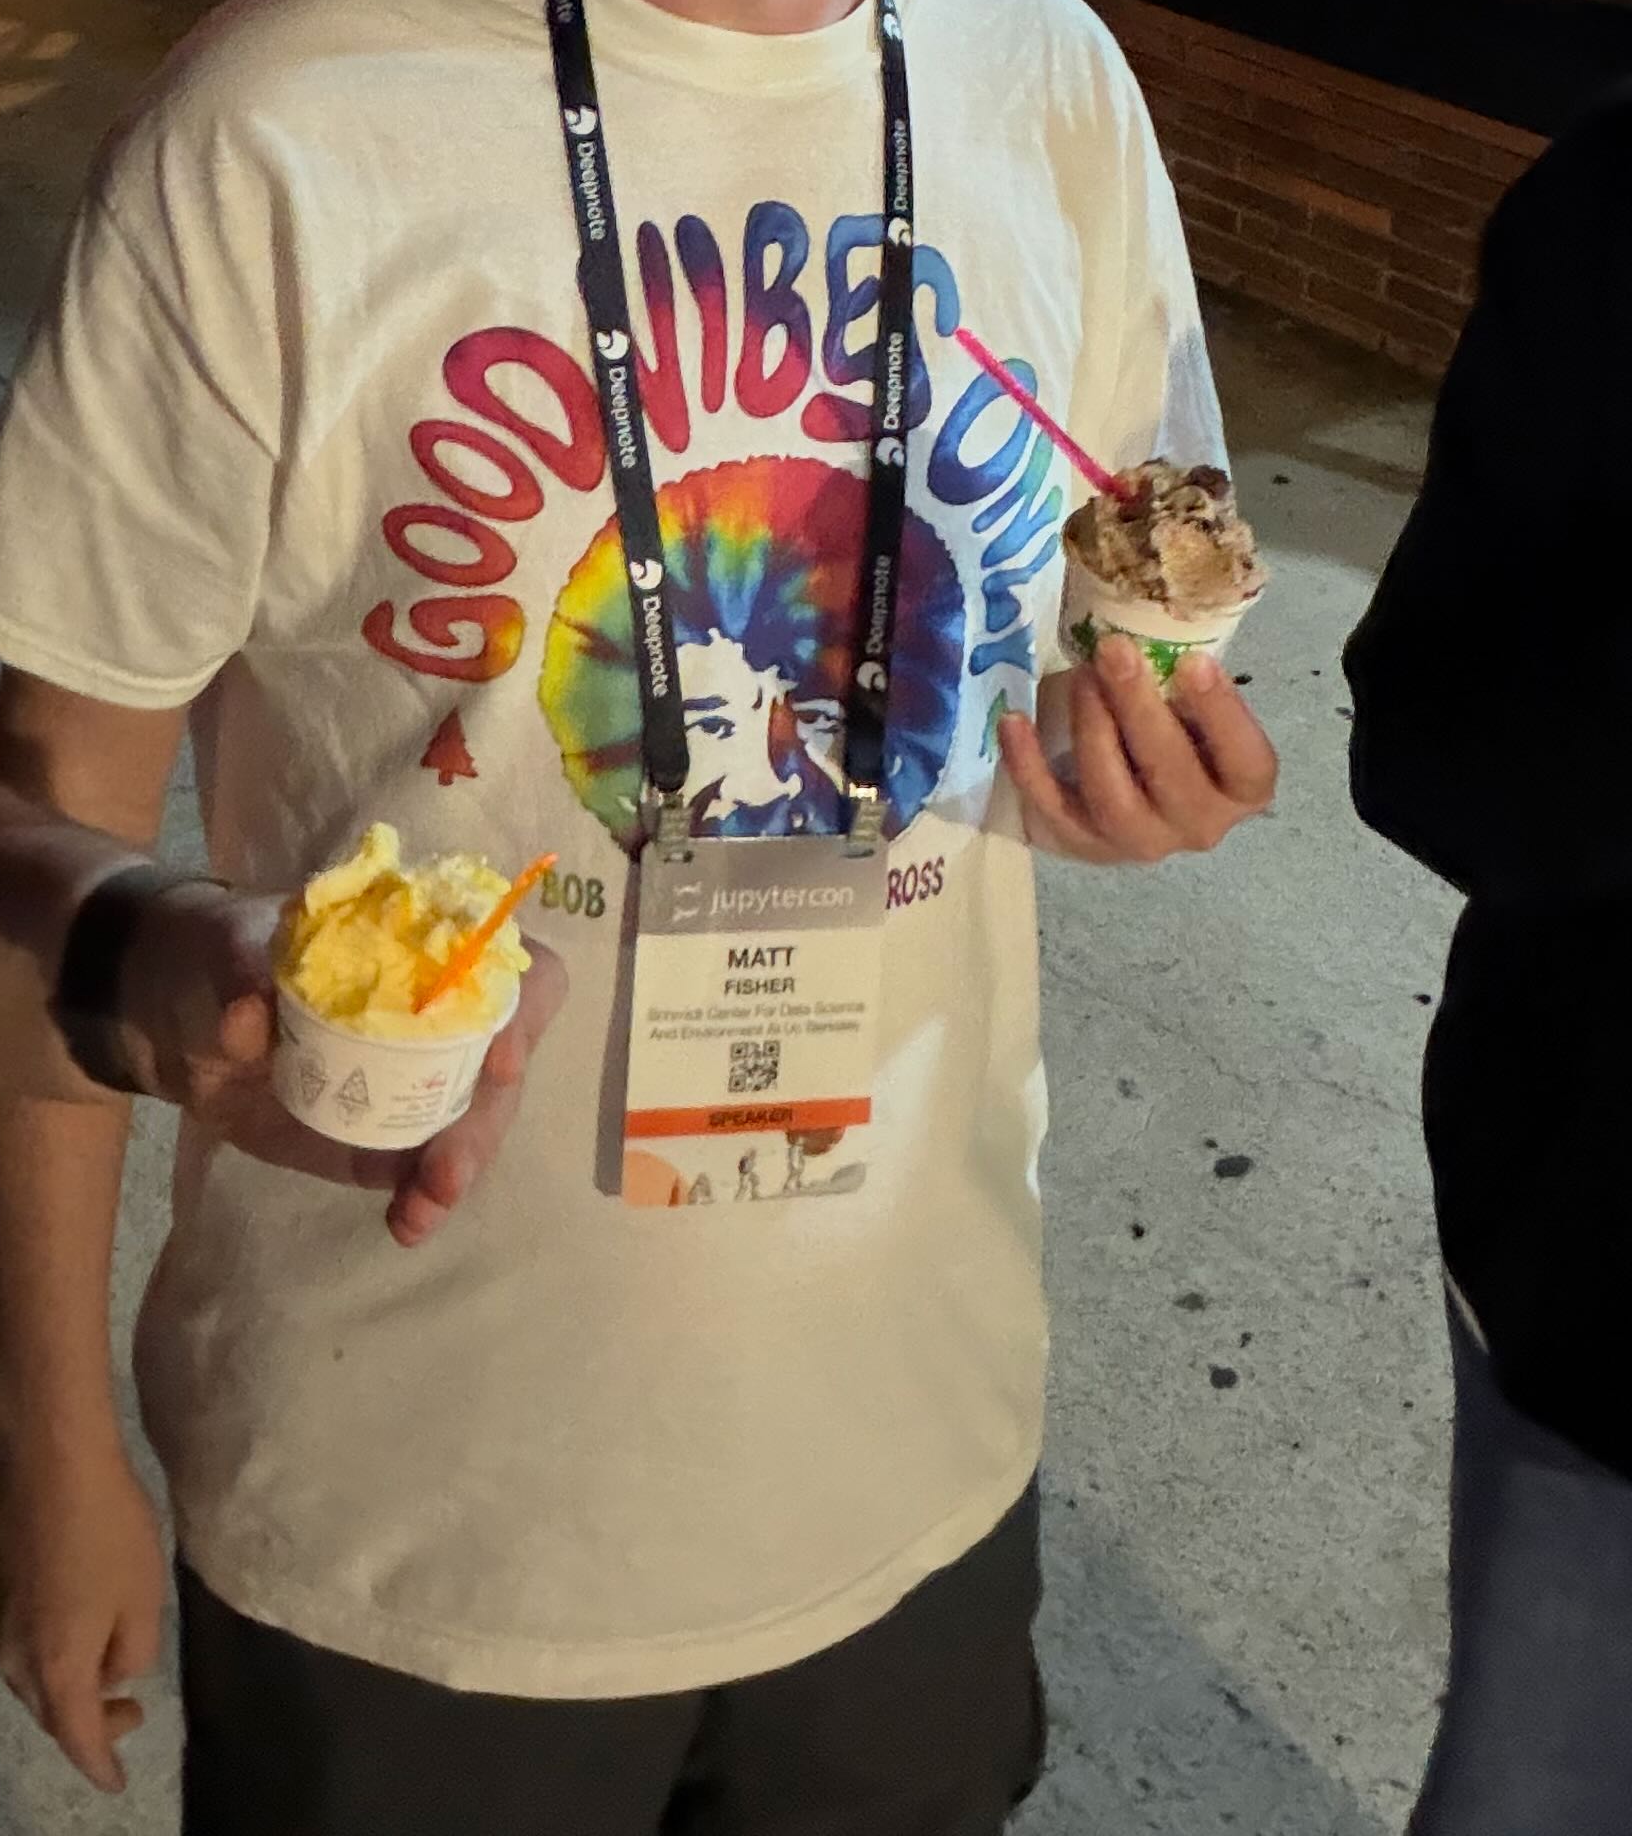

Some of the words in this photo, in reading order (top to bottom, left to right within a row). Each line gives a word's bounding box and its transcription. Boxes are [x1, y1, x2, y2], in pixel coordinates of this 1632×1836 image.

[577, 141, 606, 241] Deepnote
[893, 118, 911, 212] Deepnote
[609, 365, 638, 469] Deepnote
[883, 330, 905, 430] Deepnote
[361, 326, 606, 682] GOOD
[632, 201, 961, 454] VIBES
[927, 357, 1063, 676] ONLY
[643, 595, 669, 699] Deepnote
[865, 555, 892, 655] Deepnote
[539, 868, 606, 919] BOB
[885, 856, 946, 910] ROSS
[723, 976, 796, 996] FISHER
[727, 946, 797, 970] MATT
[707, 1107, 794, 1129] SPEAKER
